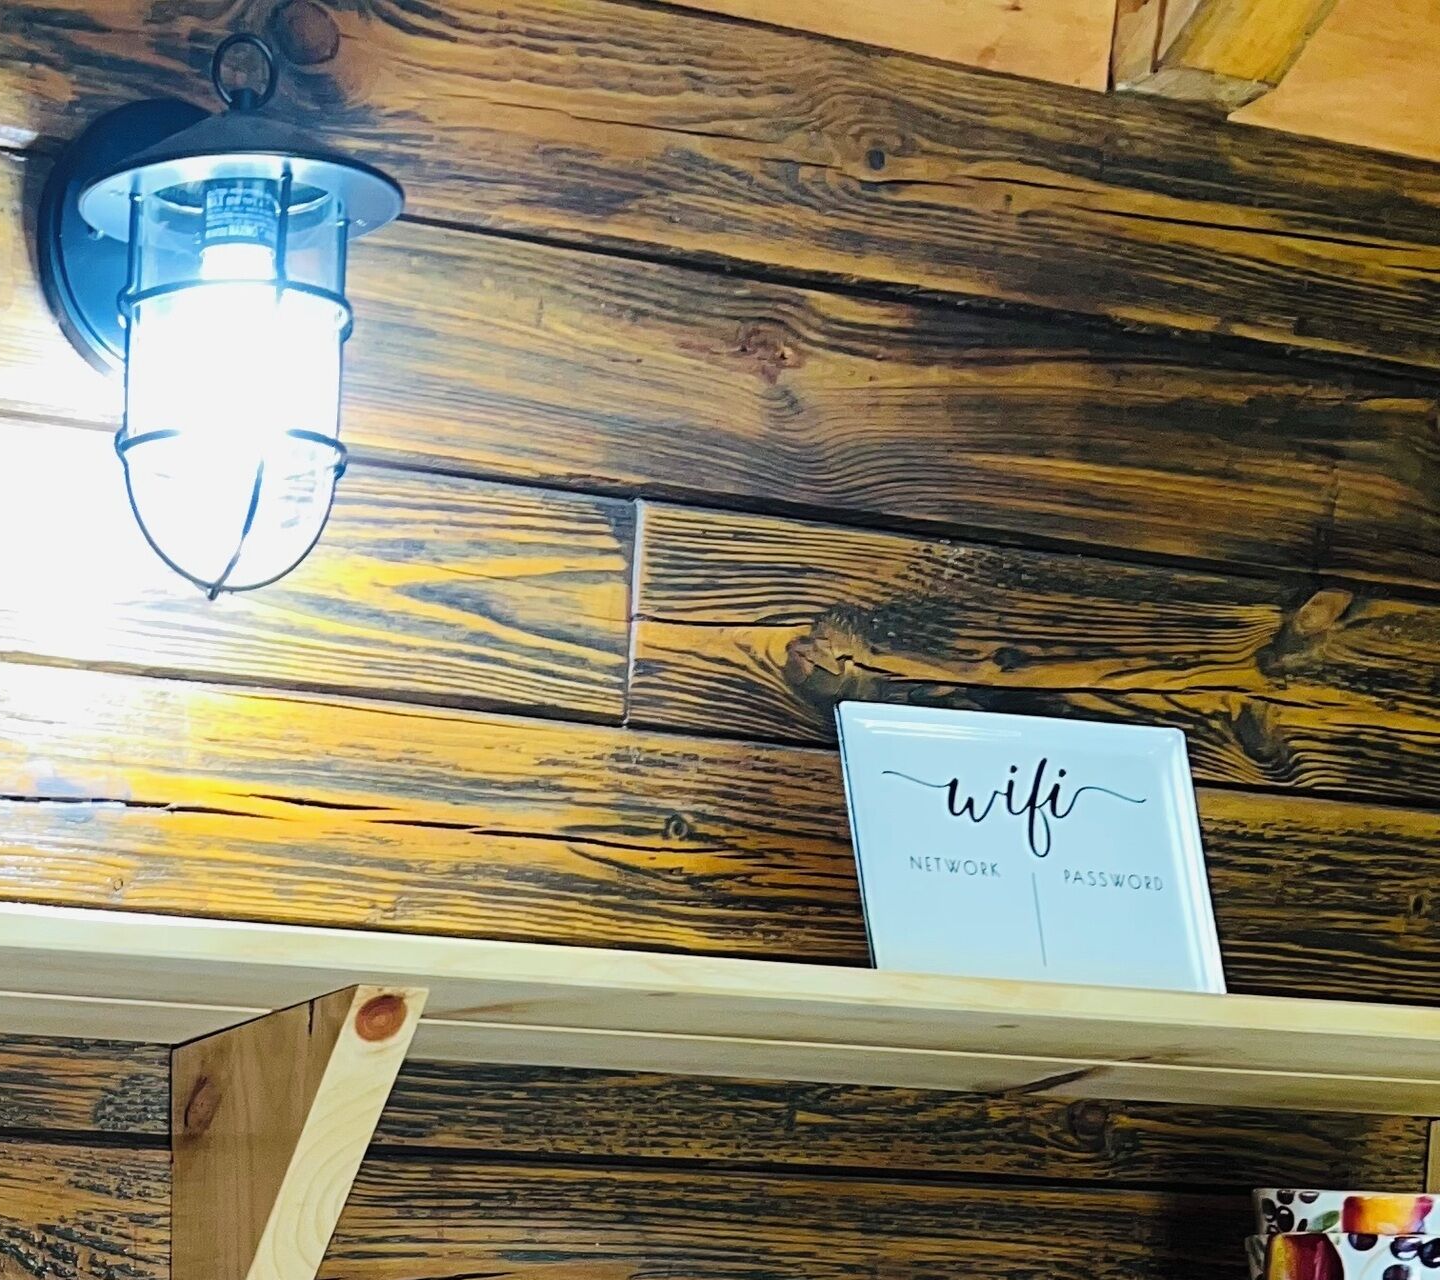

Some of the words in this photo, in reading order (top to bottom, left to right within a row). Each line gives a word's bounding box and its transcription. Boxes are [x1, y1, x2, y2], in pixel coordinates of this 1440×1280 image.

[882, 758, 1147, 858] wifi
[909, 855, 1001, 878] NETWORK
[1063, 869, 1164, 892] PASSWORD
